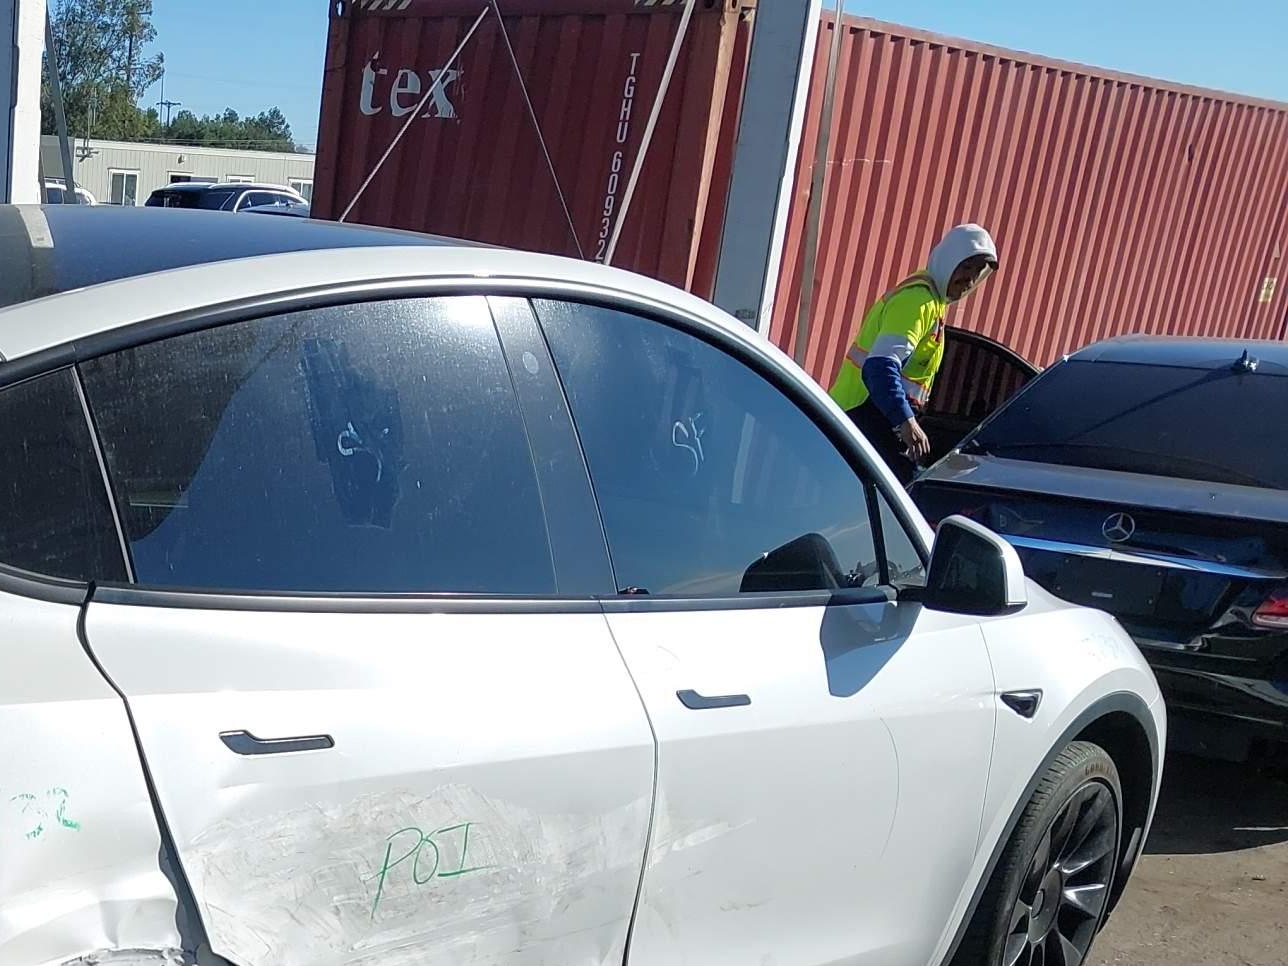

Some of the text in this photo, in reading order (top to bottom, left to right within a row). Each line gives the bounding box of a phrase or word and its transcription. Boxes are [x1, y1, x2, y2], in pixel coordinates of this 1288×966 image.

[359, 50, 458, 119] tex
[594, 53, 641, 264] TGHU 60932
